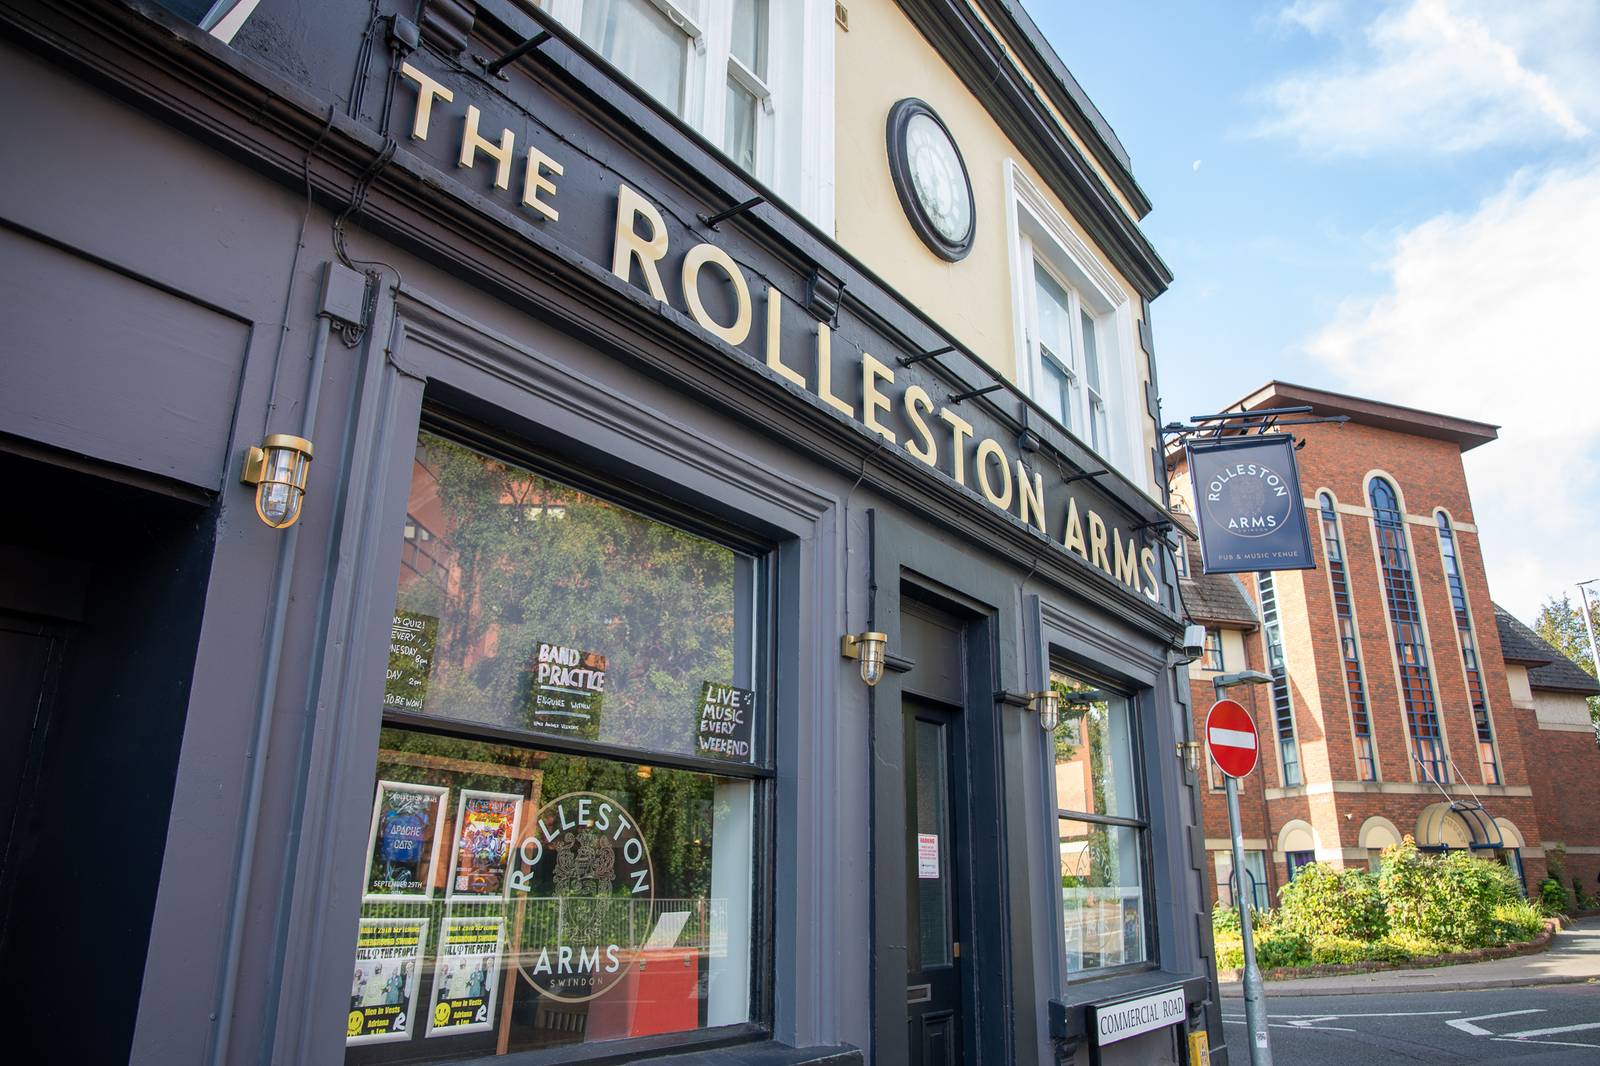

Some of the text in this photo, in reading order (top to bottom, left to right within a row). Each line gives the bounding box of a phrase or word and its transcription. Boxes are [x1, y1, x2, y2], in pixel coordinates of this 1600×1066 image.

[402, 61, 1160, 604] THE ROLLESTON ARMS
[1208, 464, 1288, 501] ROLLESTON
[1228, 515, 1277, 529] ARMS
[402, 618, 425, 630] QUIZ!
[391, 631, 417, 641] EVERY
[538, 644, 580, 667] BAND
[538, 663, 606, 692] PRACTICE
[706, 685, 741, 707] LIVE
[702, 704, 744, 724] MUSIC
[700, 720, 736, 734] EVERY
[699, 736, 749, 755] WEEKEND
[391, 824, 422, 837] APACHE
[393, 839, 413, 850] CATS
[511, 799, 649, 894] ROLLESTON
[464, 944, 476, 955] THE
[533, 944, 620, 975] ARMS
[550, 977, 604, 988] SWINDON
[1100, 997, 1184, 1036] COMMERCIAL ROAD
